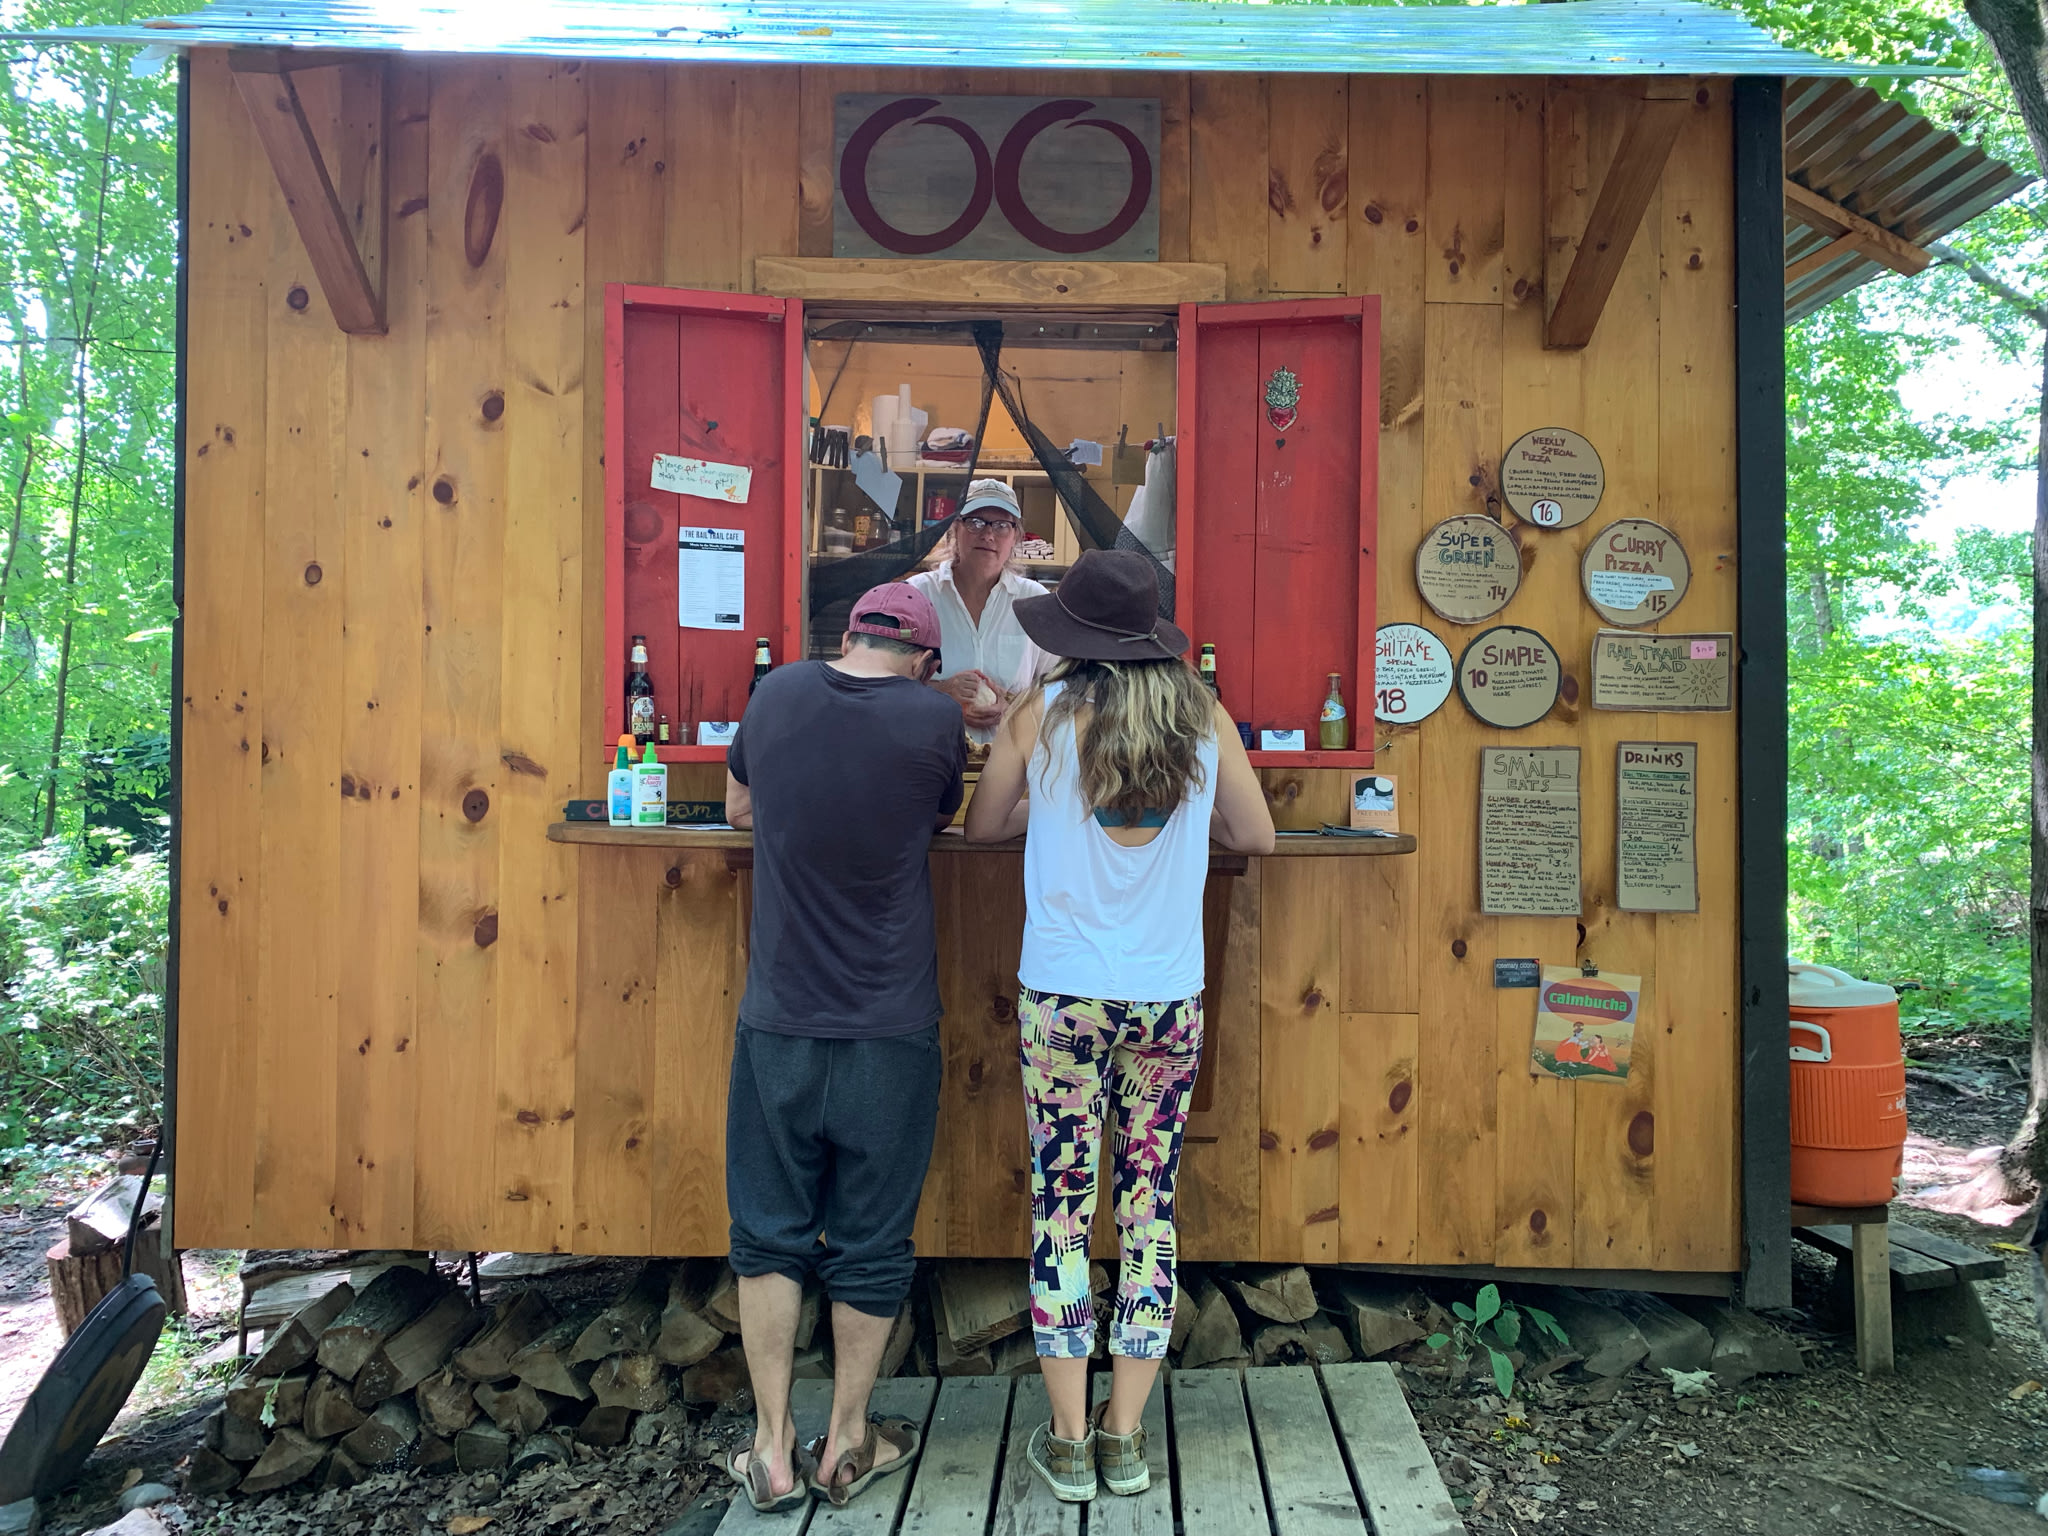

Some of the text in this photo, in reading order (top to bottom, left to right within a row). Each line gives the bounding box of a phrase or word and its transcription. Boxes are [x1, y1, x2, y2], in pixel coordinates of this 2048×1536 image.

[1531, 436, 1566, 446] WEEKLY
[1521, 451, 1551, 464] PIZZA
[1541, 446, 1577, 458] SPECIAL
[657, 459, 683, 473] Please
[684, 465, 699, 475] put
[1537, 503, 1553, 522] 16
[684, 530, 695, 539] THE
[696, 531, 708, 539] RAIL
[726, 533, 739, 541] CAFE
[1436, 531, 1494, 549] SUPER
[1609, 533, 1667, 562] CURRY
[1439, 548, 1495, 568] GREEN
[1604, 553, 1655, 574] PIZZA
[1376, 638, 1434, 661] SHITAKE
[1482, 645, 1547, 667] SIMPLE
[1607, 643, 1637, 661] RAIL
[1622, 660, 1687, 675] SALAD
[1468, 668, 1488, 688] 10
[1493, 754, 1571, 779] SMALL
[1625, 751, 1684, 768] DRINKS
[1508, 779, 1550, 792] EATS
[1549, 991, 1628, 1013] calmbucha
